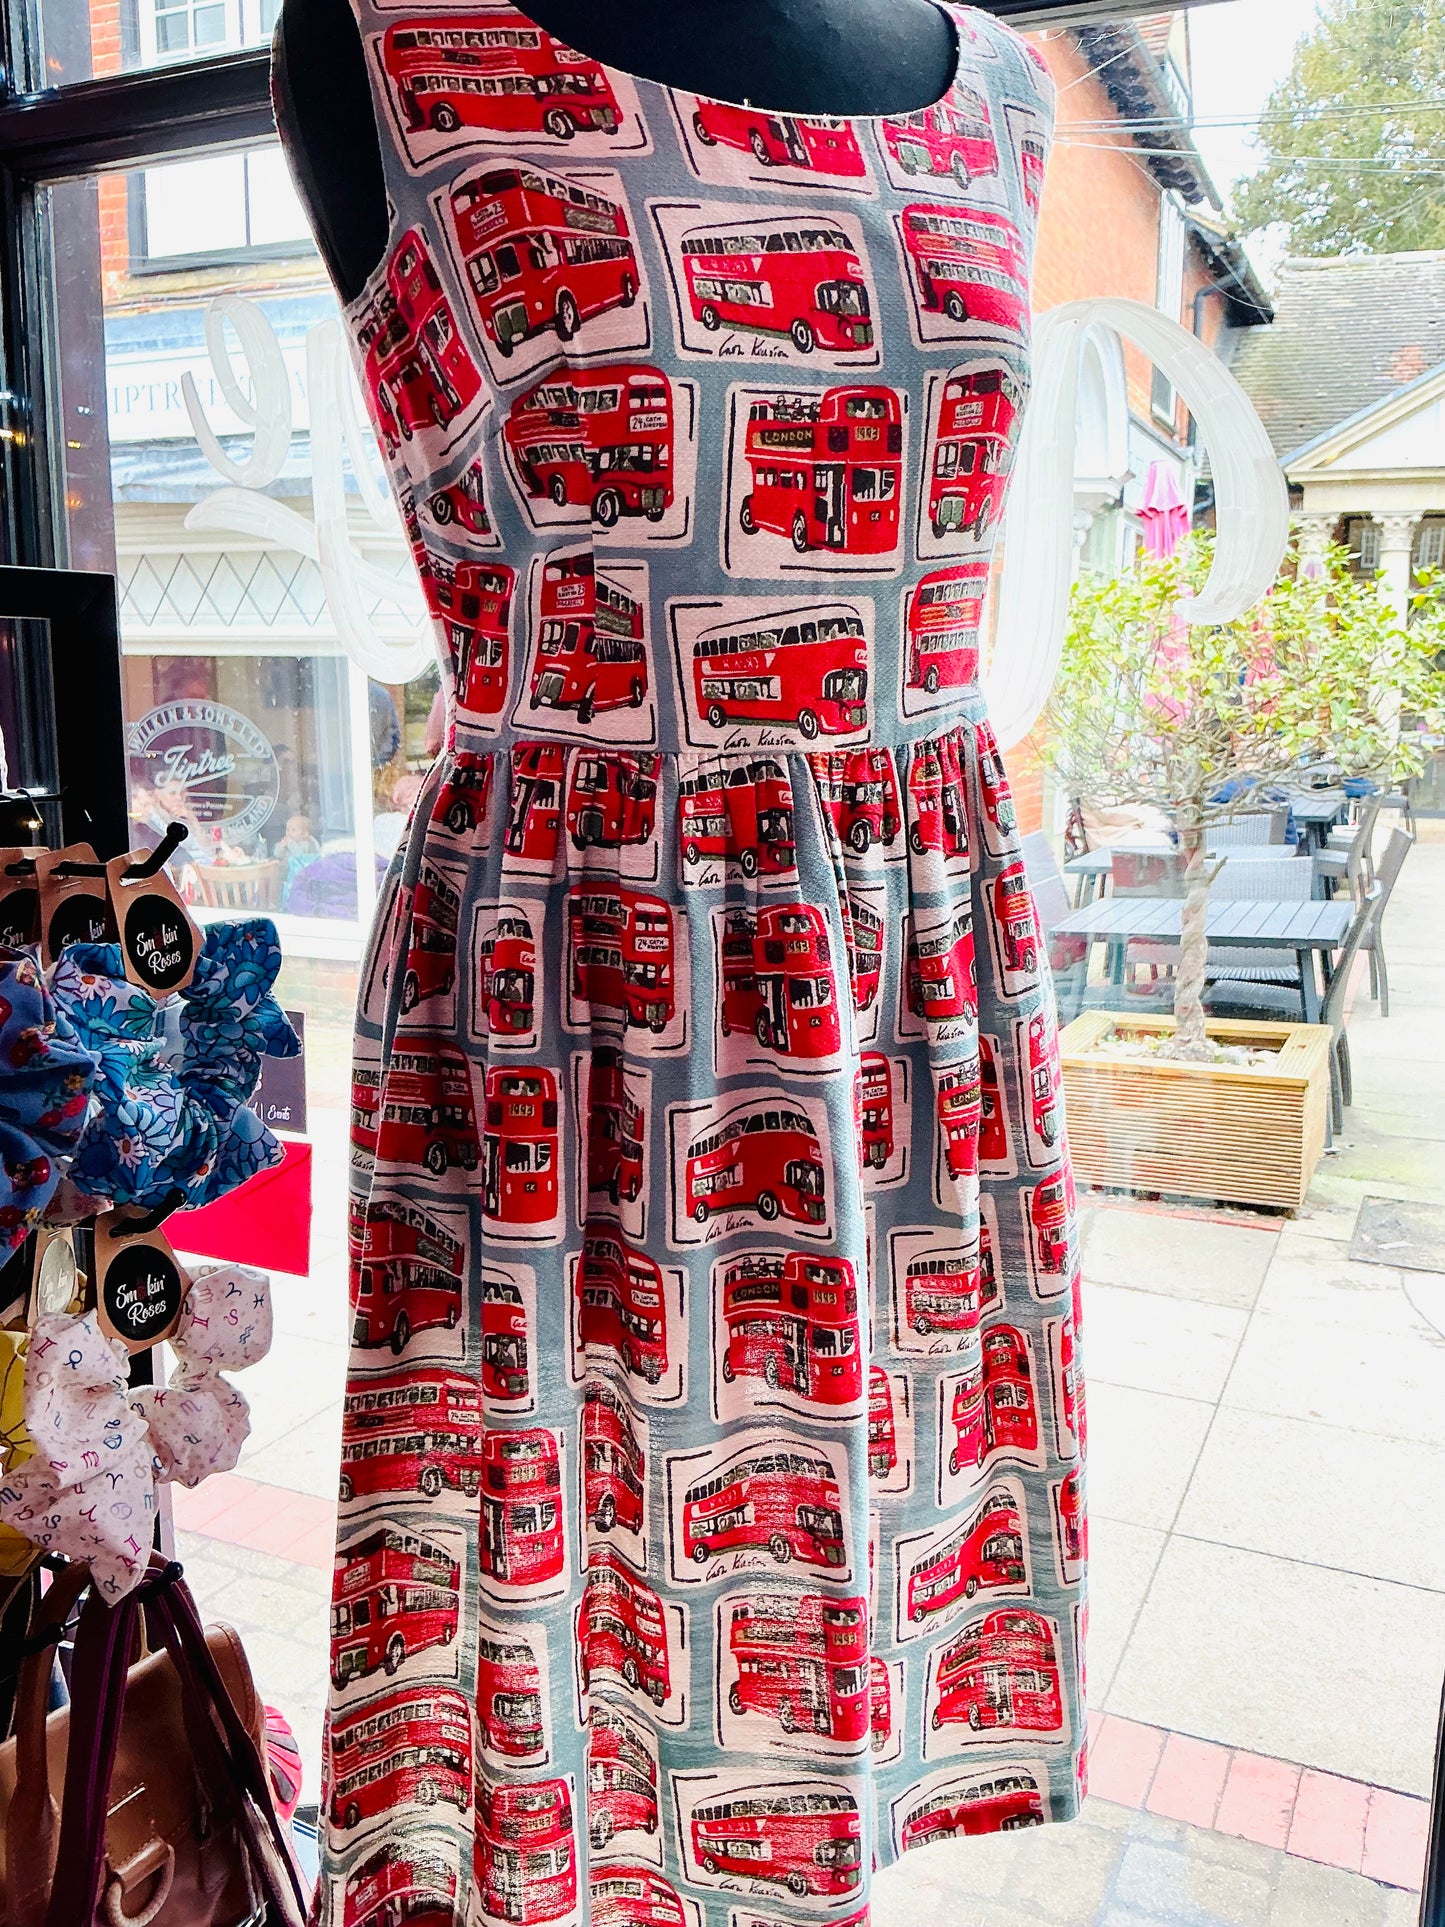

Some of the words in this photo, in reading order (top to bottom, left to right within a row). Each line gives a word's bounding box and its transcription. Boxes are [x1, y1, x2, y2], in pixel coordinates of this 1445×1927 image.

[765, 429, 813, 443] LONDON
[154, 744, 236, 793] Tiptree
[148, 951, 182, 975] Roses
[735, 1283, 779, 1300] LONDON
[127, 1300, 167, 1327] Roses
